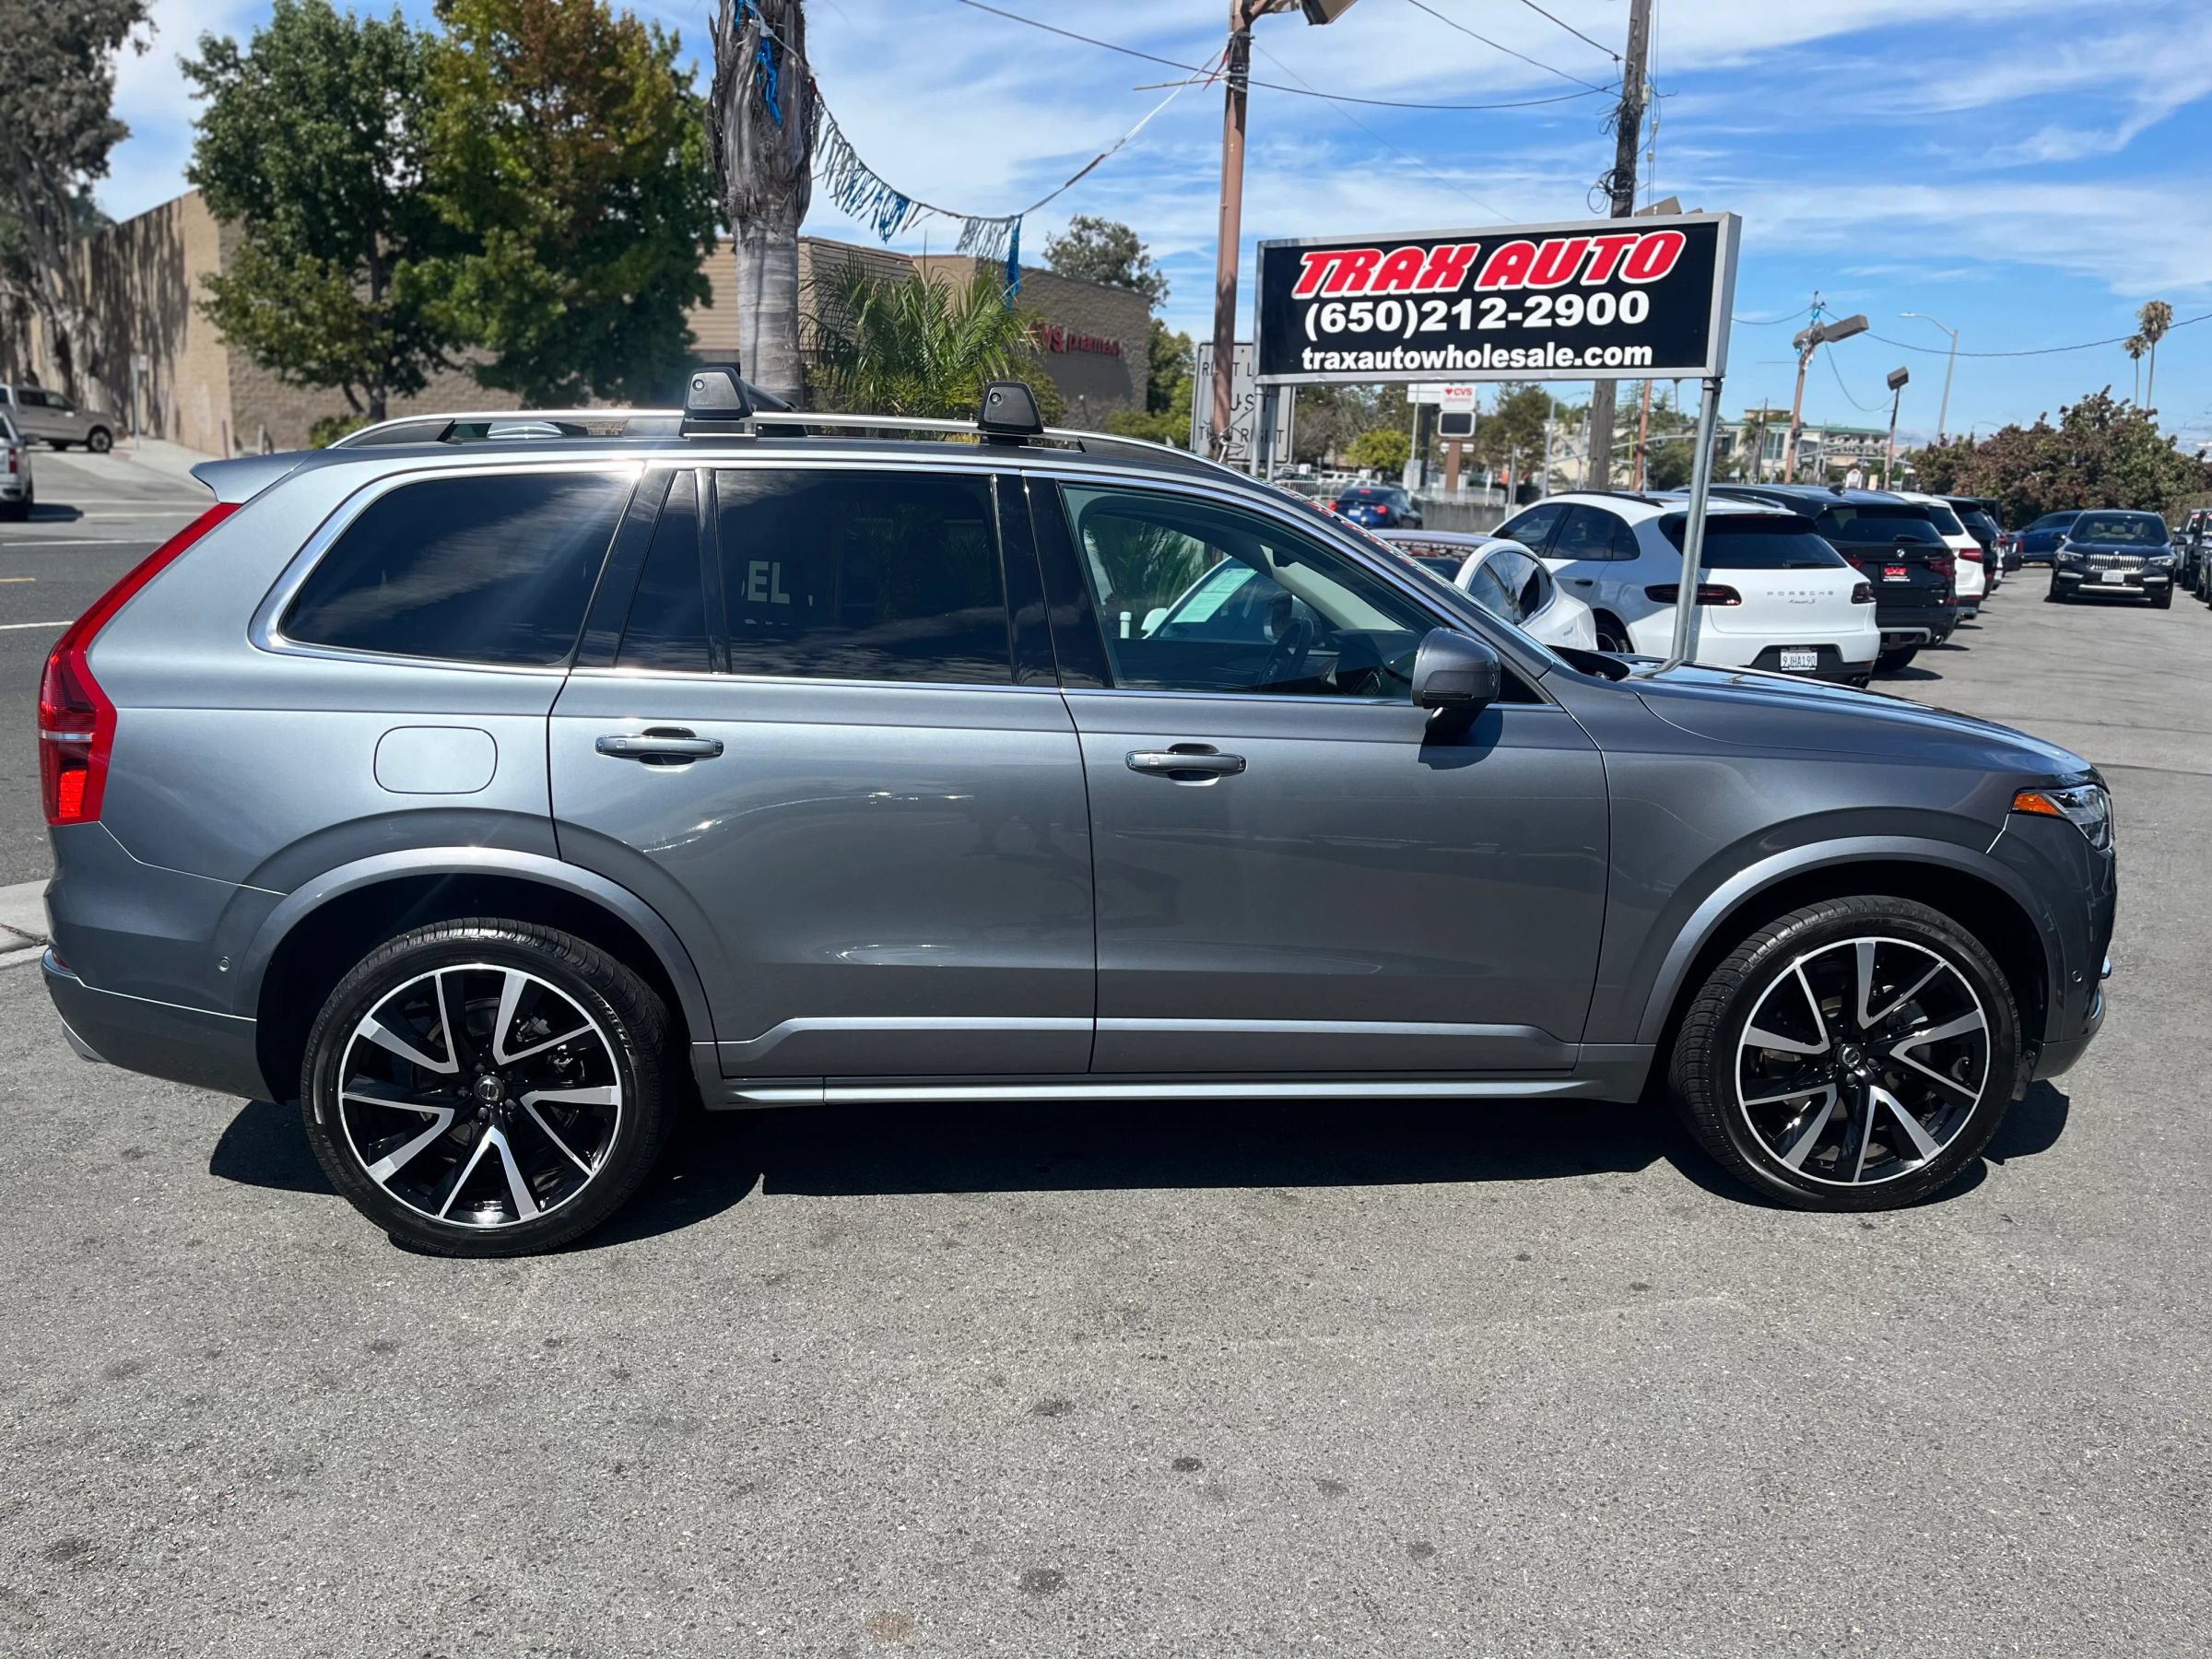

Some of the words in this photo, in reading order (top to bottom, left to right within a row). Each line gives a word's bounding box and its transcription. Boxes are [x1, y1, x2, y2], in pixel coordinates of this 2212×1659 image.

[1291, 242, 1481, 300] TRAX
[1474, 229, 1687, 291] AUTO
[1304, 290, 1650, 342] (650)212-2900
[1301, 341, 1653, 371] traxautowholesale.com
